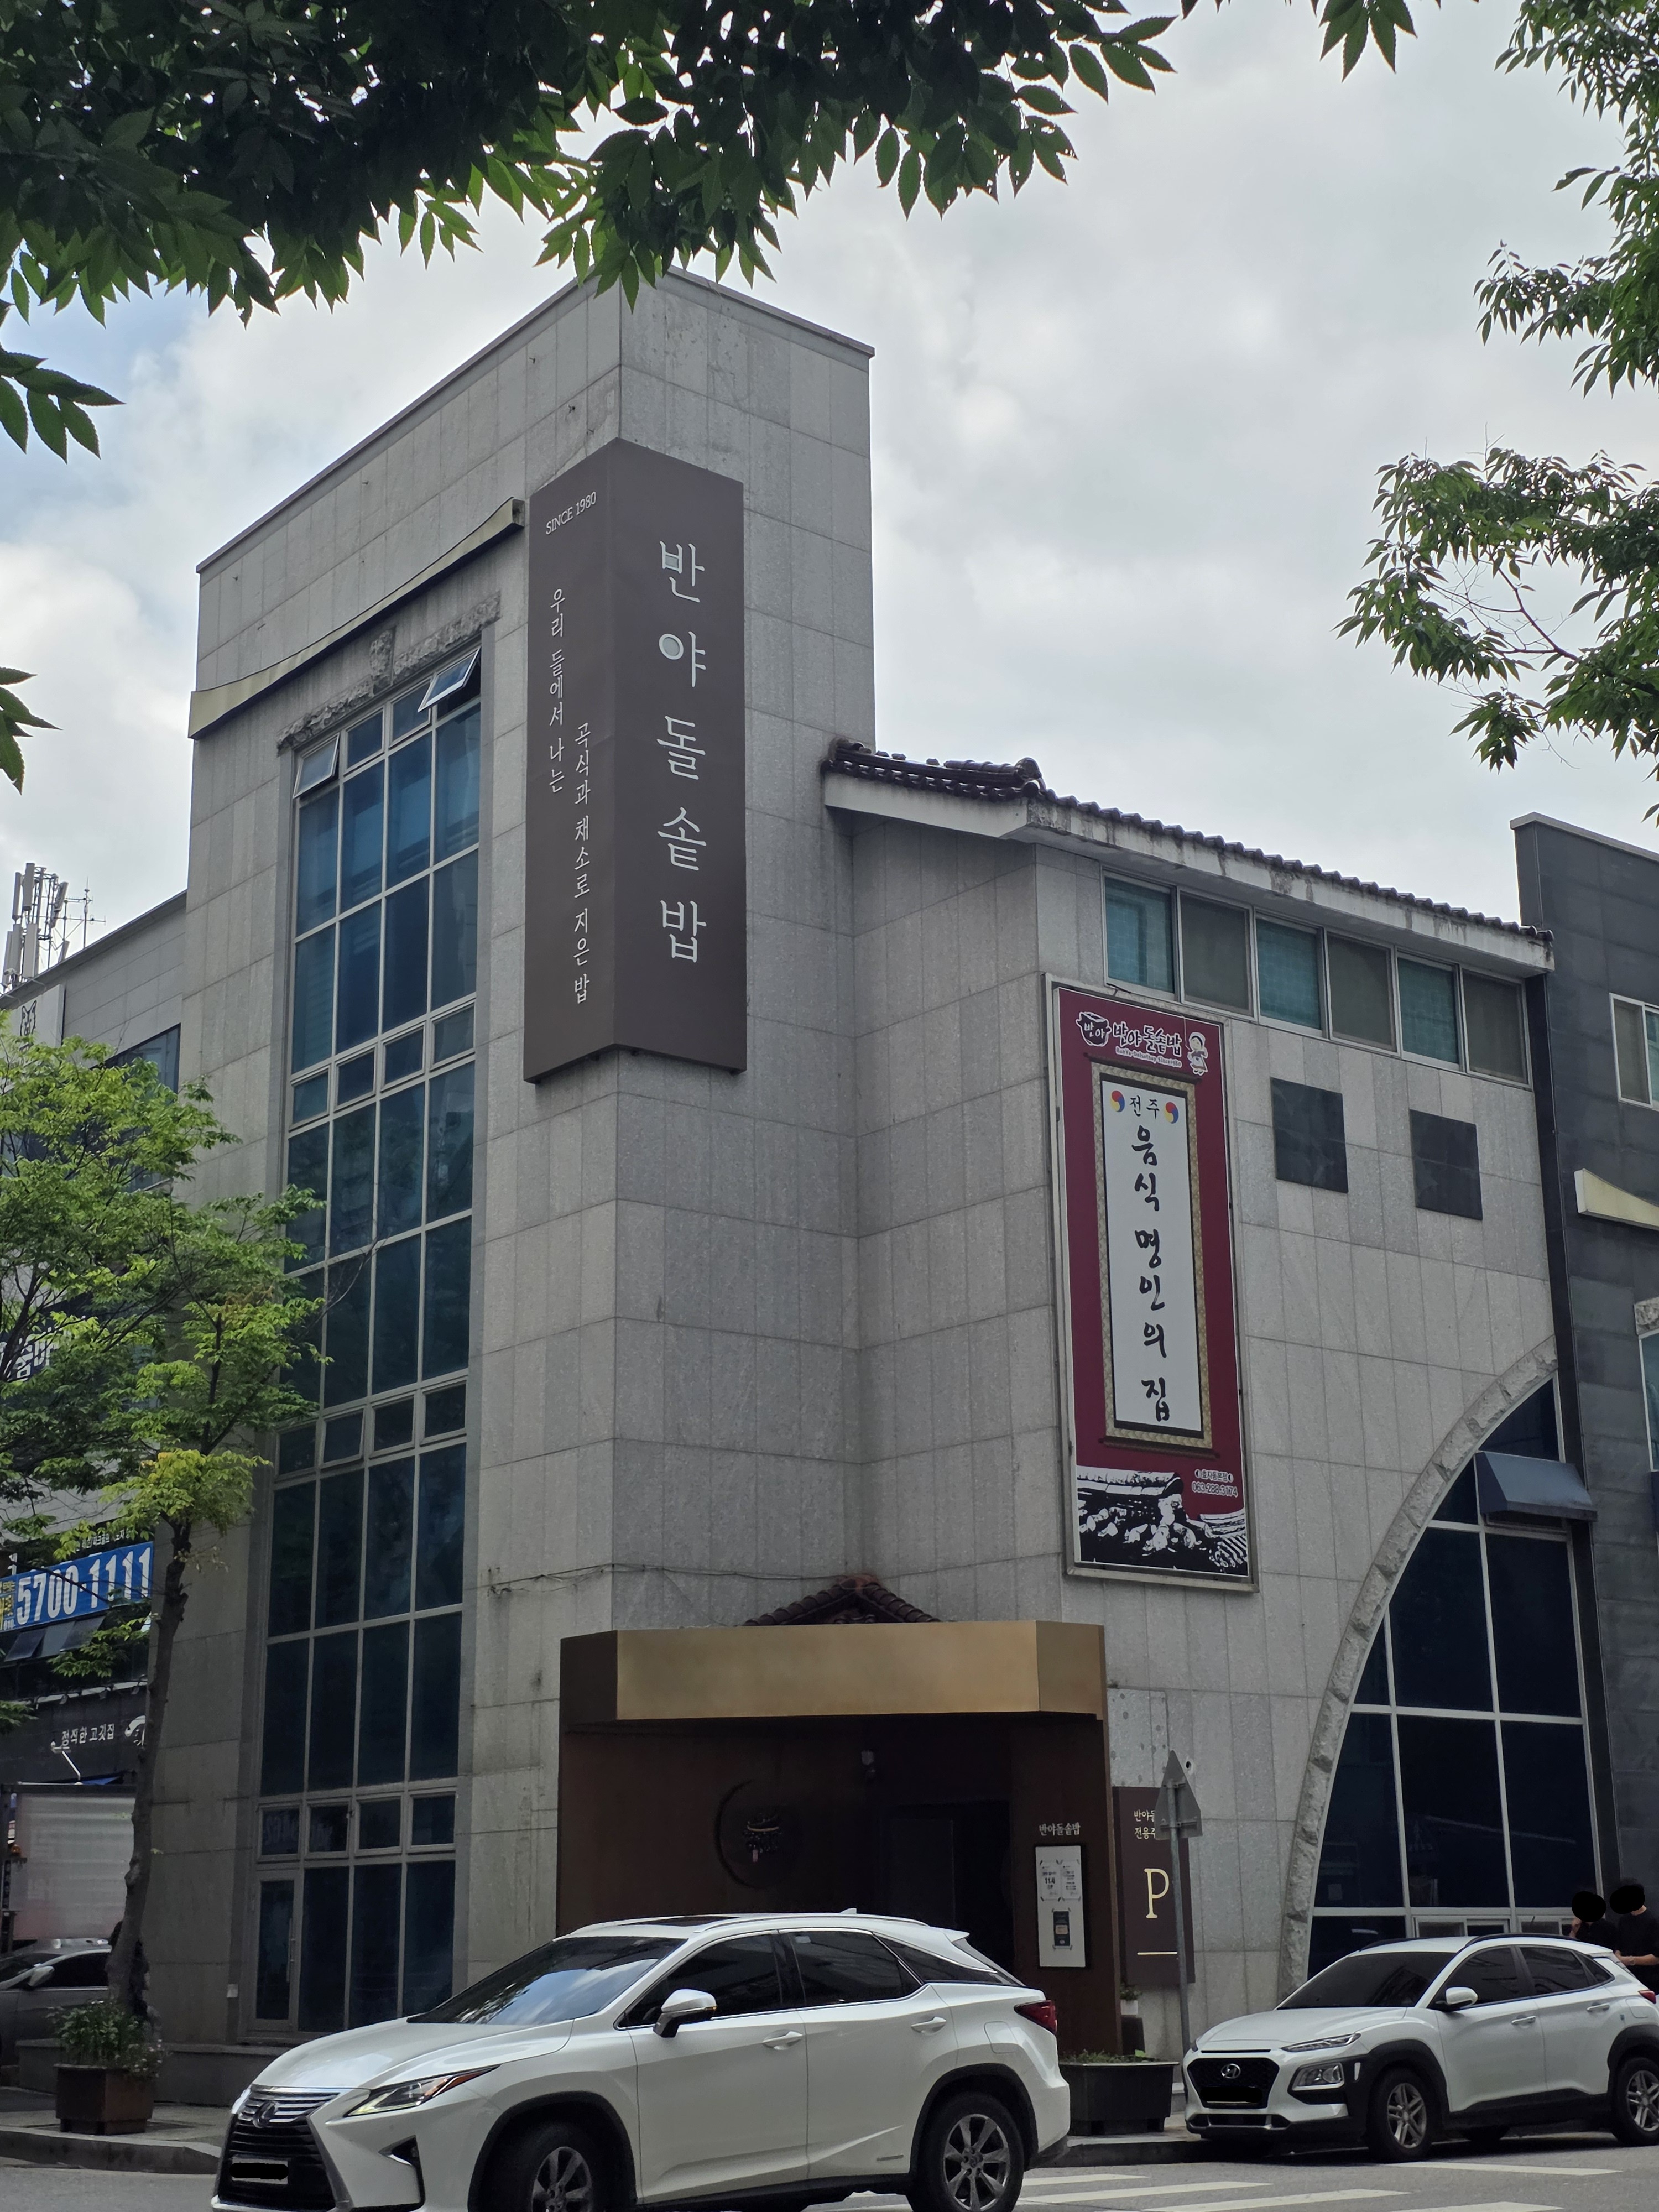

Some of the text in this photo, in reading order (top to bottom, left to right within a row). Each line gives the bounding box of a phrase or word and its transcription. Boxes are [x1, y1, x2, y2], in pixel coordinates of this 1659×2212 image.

[546, 491, 597, 535] SINCE 1980
[549, 588, 565, 793] 우리 들에서 나는
[657, 541, 707, 963] 반야돌솥밥
[573, 722, 591, 1004] 곡식과 채소로 지은 밥
[1084, 1022, 1105, 1039] 반야
[1113, 1021, 1182, 1056] 반야돌솥밥
[1130, 1095, 1160, 1119] 전주
[1131, 1125, 1170, 1422] 음식 명인의 집
[17, 1547, 150, 1625] 5700-1111
[61, 1723, 114, 1746] 정직한 고깃집
[1144, 1868, 1170, 1919] P
